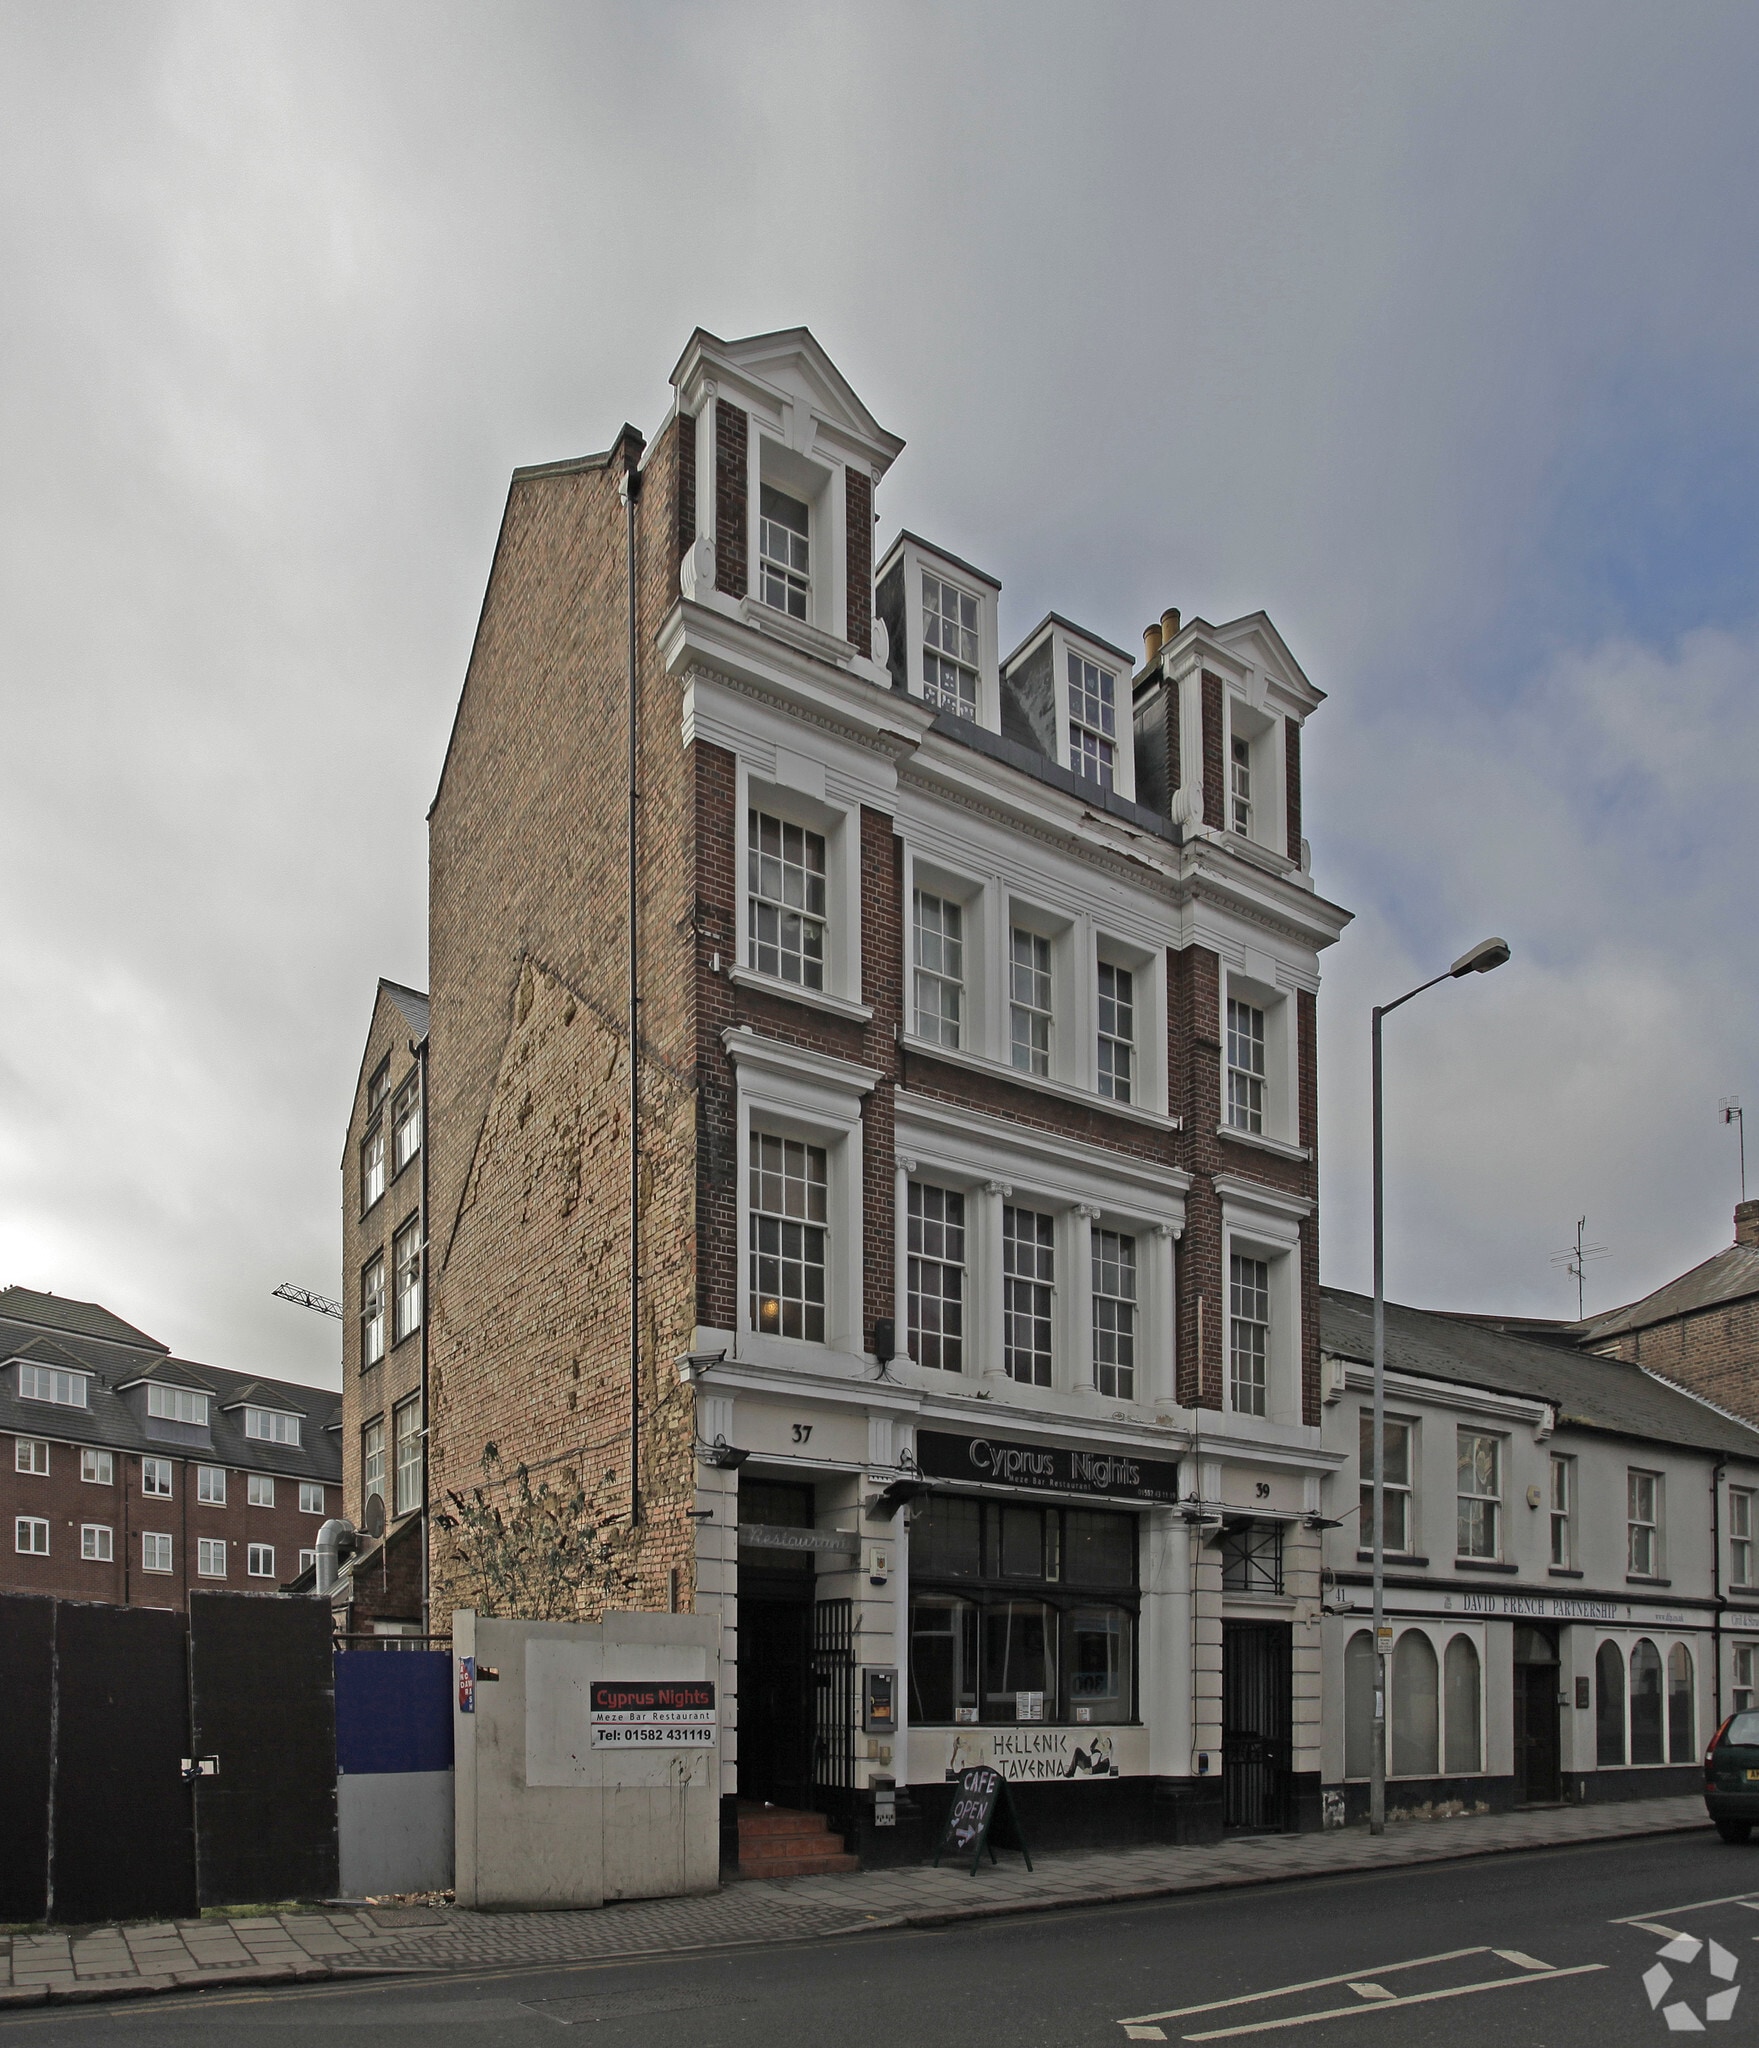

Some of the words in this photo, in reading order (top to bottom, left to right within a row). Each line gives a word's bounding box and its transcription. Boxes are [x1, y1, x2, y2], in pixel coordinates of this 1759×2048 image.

[791, 1424, 813, 1443] 37
[969, 1438, 1054, 1477] Cyprus
[1071, 1452, 1140, 1488] Nights
[1008, 1474, 1028, 1484] Meze
[1032, 1477, 1045, 1485] Bar
[1049, 1478, 1091, 1490] Restaurant
[1255, 1483, 1270, 1498] 39
[749, 1527, 848, 1549] Restaurant
[1335, 1588, 1346, 1602] 41
[1463, 1594, 1496, 1612] DAVID
[1503, 1596, 1545, 1615] FRENCH
[1552, 1600, 1618, 1619] PARTNERSHIP
[596, 1689, 655, 1709] Cyprus
[658, 1689, 709, 1708] Nights
[596, 1713, 624, 1721] Meze
[629, 1713, 647, 1721] Bar
[653, 1712, 710, 1721] Restaurant
[597, 1729, 621, 1741] Tel:
[624, 1729, 663, 1741] 01582
[666, 1729, 712, 1741] 431119
[993, 1734, 1067, 1755] HELLENIC
[998, 1759, 1066, 1779] TAVERNA
[963, 1772, 997, 1794] CAFE
[953, 1800, 988, 1820] OPEN
